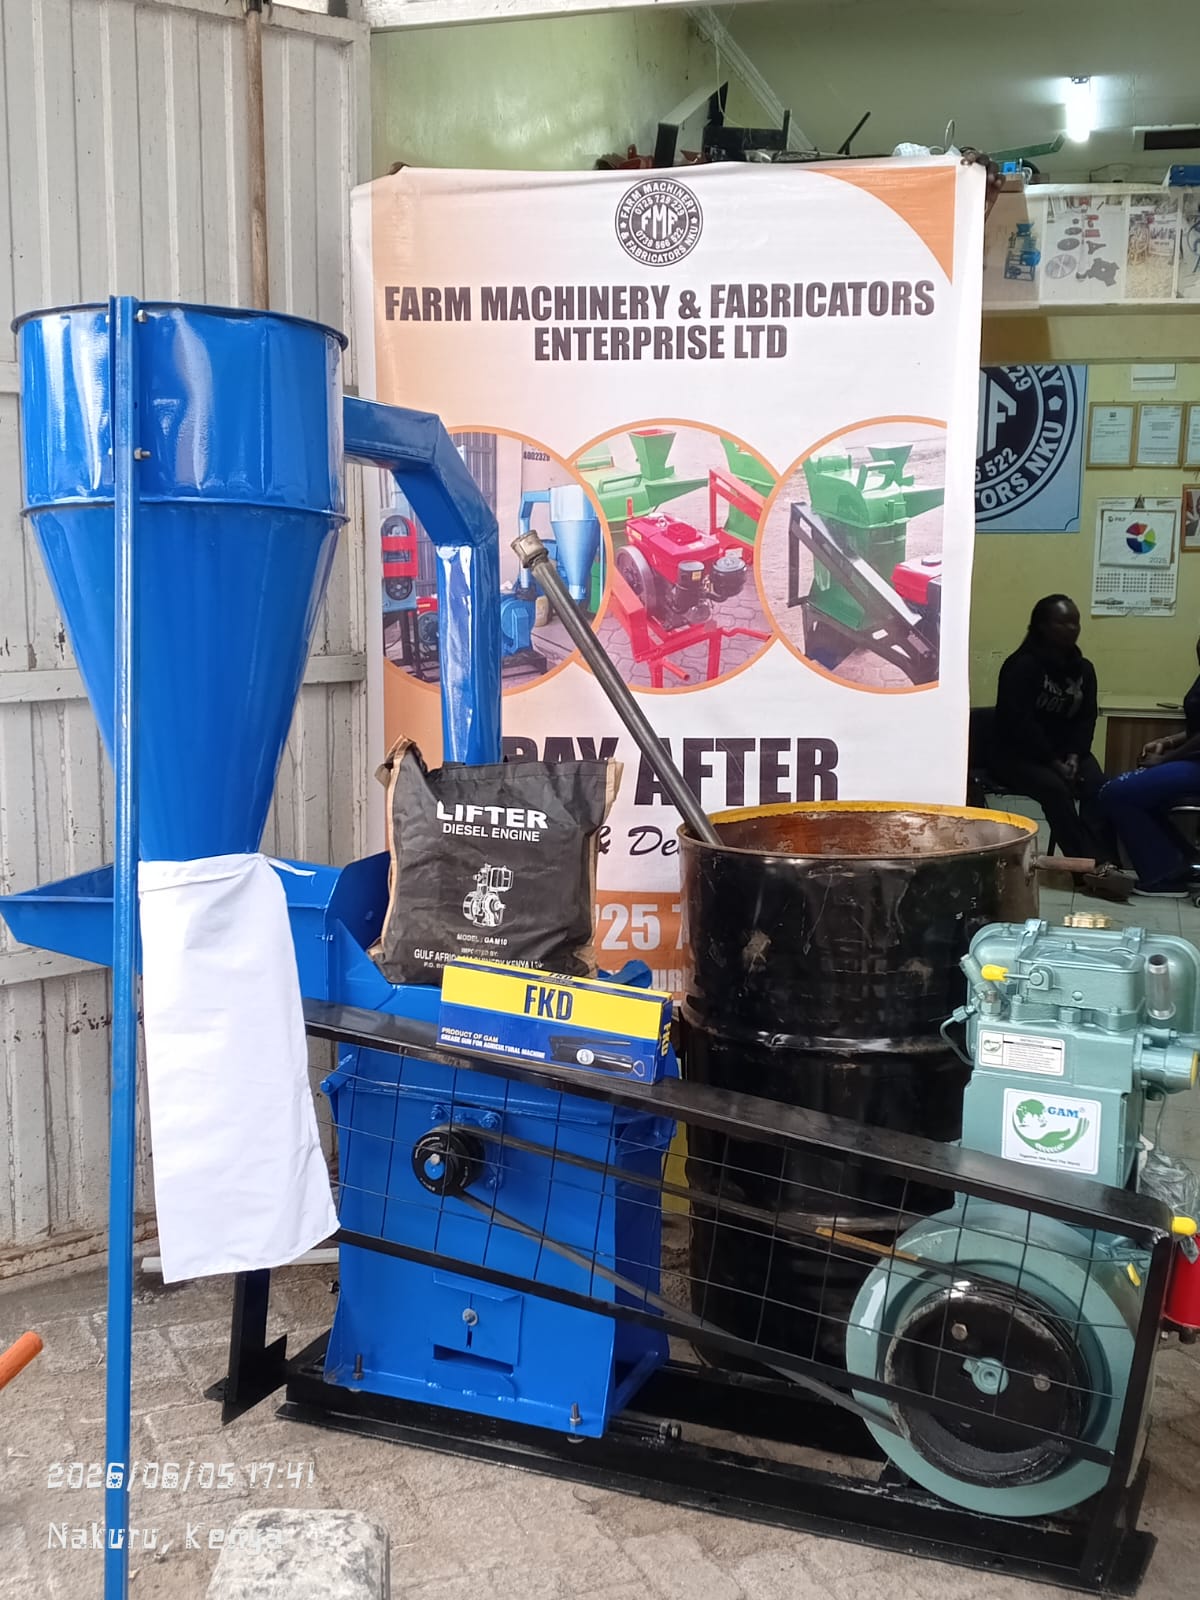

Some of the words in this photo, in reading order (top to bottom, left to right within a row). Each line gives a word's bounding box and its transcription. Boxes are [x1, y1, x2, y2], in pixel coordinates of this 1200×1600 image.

[620, 190, 642, 219] FARM
[643, 182, 697, 214] MACHINERY
[634, 197, 653, 215] 0725
[641, 203, 678, 240] FMF
[670, 227, 684, 243] 522
[620, 231, 629, 240] &
[626, 240, 686, 263] FABRICATORS
[684, 226, 698, 246] NKU
[385, 286, 471, 321] FARM
[481, 284, 670, 321] MACHINERY
[678, 290, 701, 319] &
[710, 280, 935, 319] FABRICATORS
[535, 324, 725, 361] ENTERPRISE
[734, 325, 787, 359] LTD
[975, 472, 1029, 509] ORS
[1025, 421, 1064, 476] NKU
[985, 447, 1018, 477] 522
[634, 737, 839, 807] AFTER
[436, 800, 548, 829] LIFTER
[442, 822, 489, 837] DIESEL
[491, 827, 540, 842] ENGINE
[627, 825, 679, 857] De
[456, 933, 479, 942] MODEL
[414, 949, 434, 960] GULF
[435, 951, 458, 961] AFRIC
[524, 984, 574, 1021] FKD
[441, 1027, 472, 1038] PRODUCT
[483, 1035, 498, 1043] GAM
[472, 1039, 483, 1048] FOR
[1047, 1106, 1079, 1118] GAM
